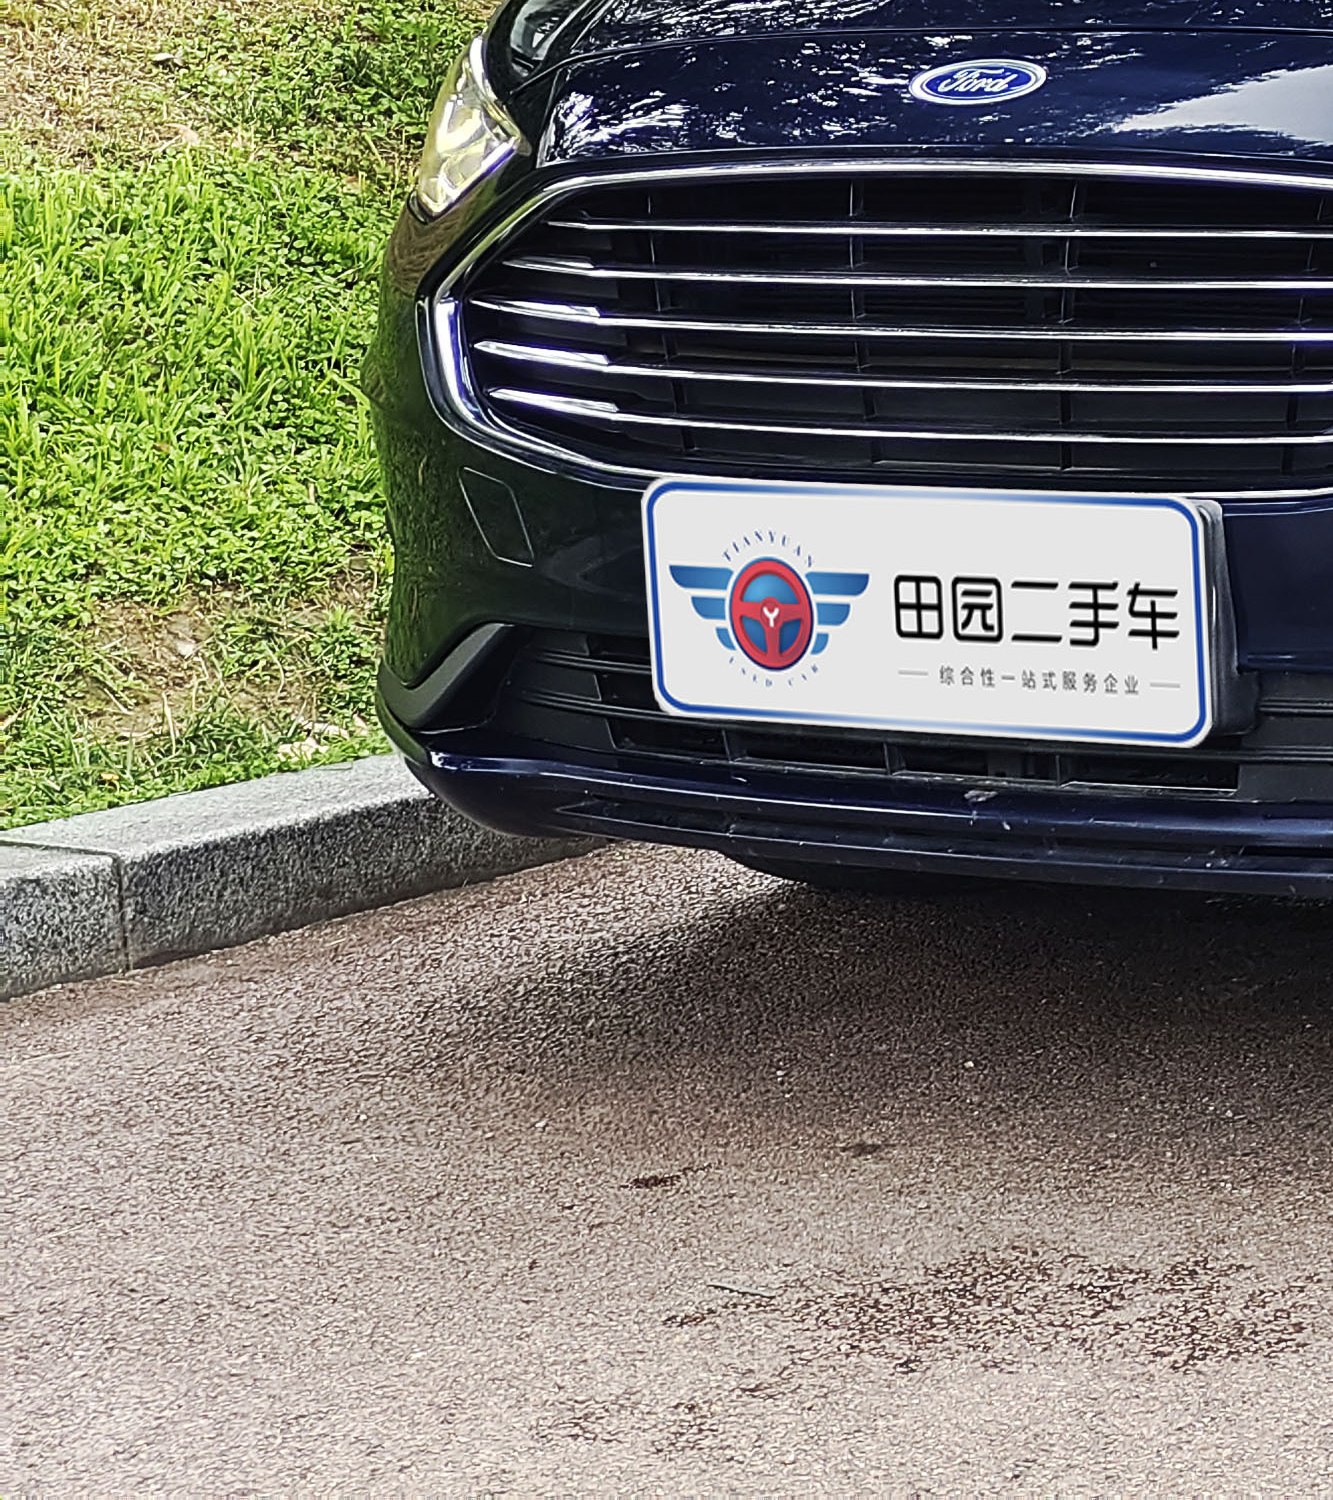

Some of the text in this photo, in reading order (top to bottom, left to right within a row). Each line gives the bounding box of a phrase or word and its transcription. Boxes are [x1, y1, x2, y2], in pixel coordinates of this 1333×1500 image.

[937, 68, 1018, 93] Ford
[893, 574, 1181, 650] 田园二手车
[938, 665, 1140, 695] 综合性一站式服务企业
